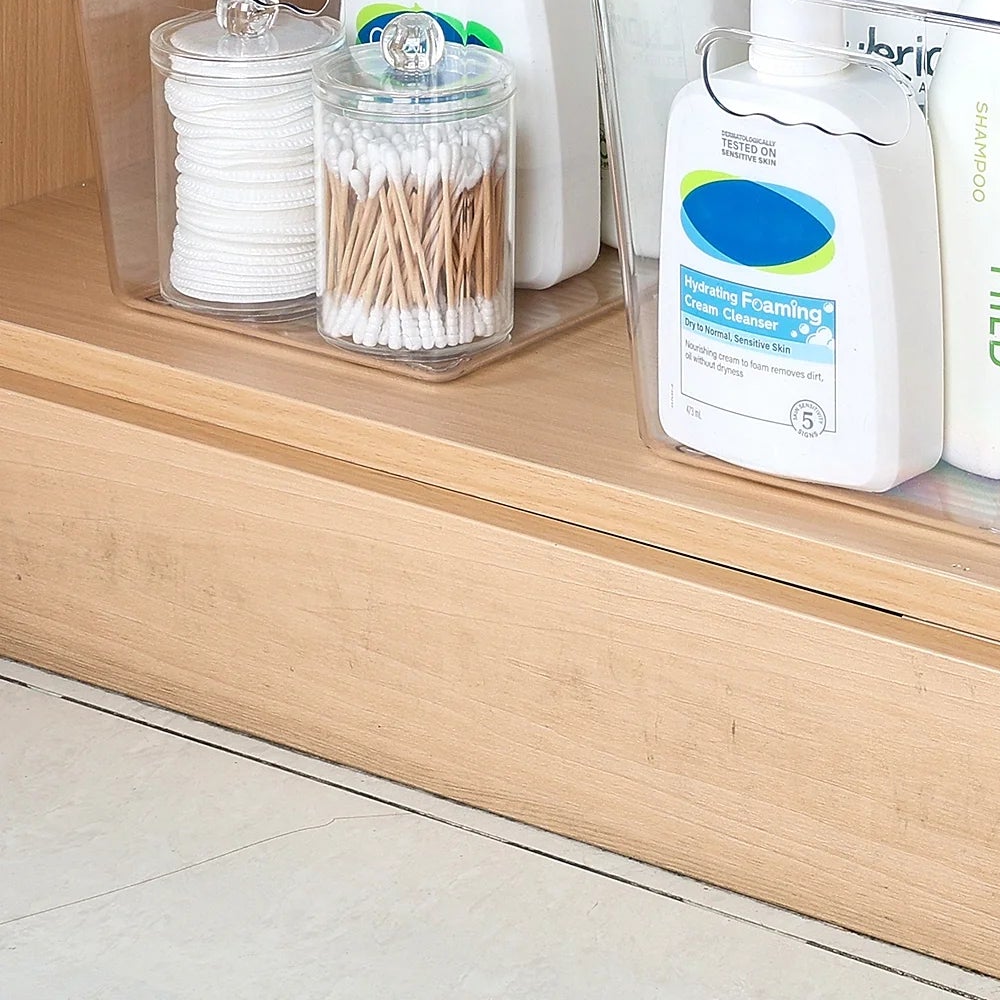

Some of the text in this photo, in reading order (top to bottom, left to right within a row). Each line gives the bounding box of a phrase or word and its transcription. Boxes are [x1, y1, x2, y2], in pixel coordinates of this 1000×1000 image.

[721, 149, 776, 166] SENSITIVE SKIN
[722, 138, 776, 158] TESTED ON
[972, 101, 989, 203] SHAMPOO
[684, 274, 822, 326] Hydrating Foaming
[684, 294, 779, 331] Cream Cleanser
[685, 317, 791, 354] Dry to Normal, Sensitive Skin
[685, 339, 824, 382] Nourishing cream to foam removes dirt,
[693, 354, 716, 369] without
[716, 363, 744, 377] dryness
[797, 429, 818, 438] SIGNS
[802, 411, 814, 430] 5
